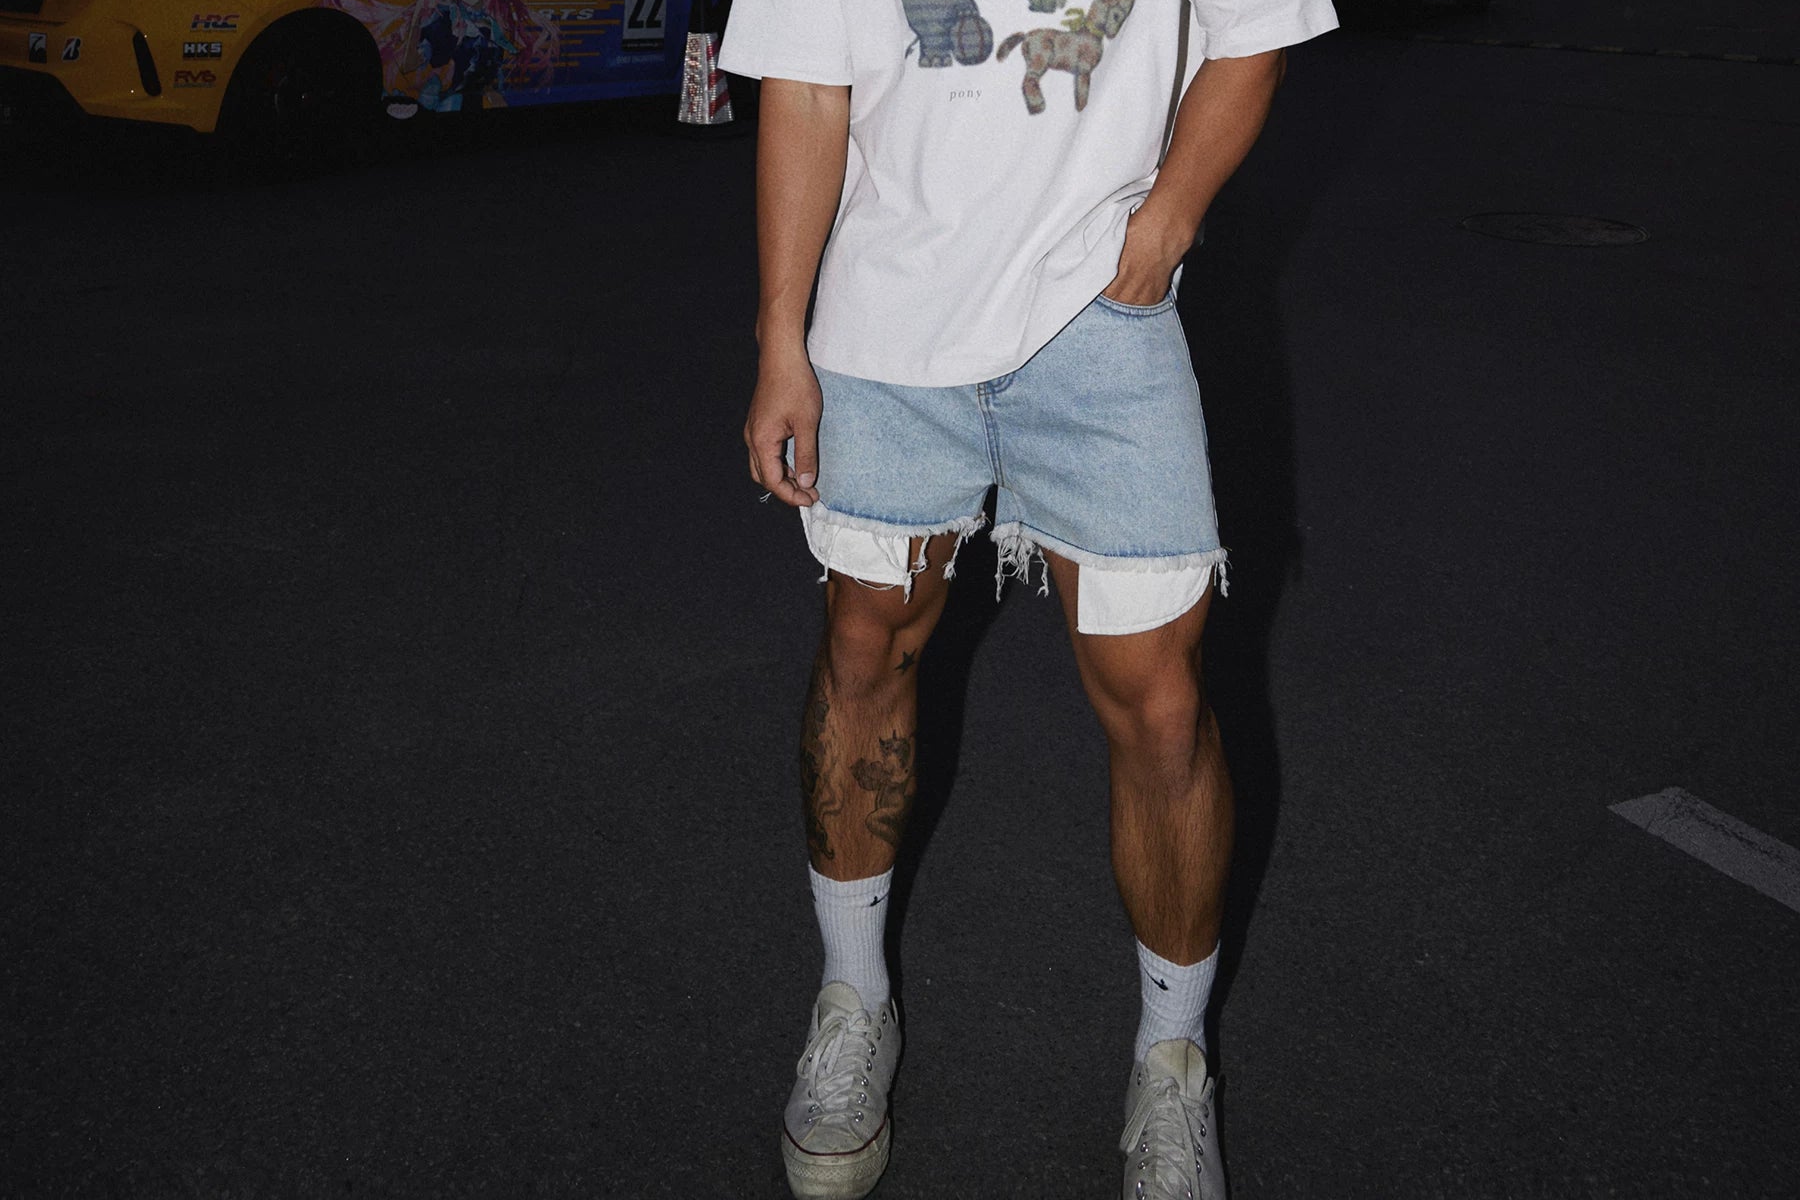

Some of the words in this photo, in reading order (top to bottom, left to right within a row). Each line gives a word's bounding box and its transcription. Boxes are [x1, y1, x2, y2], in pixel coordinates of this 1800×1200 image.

[191, 14, 240, 29] HRC
[538, 9, 595, 22] RTS
[184, 43, 222, 54] HKS
[949, 89, 983, 102] pony
